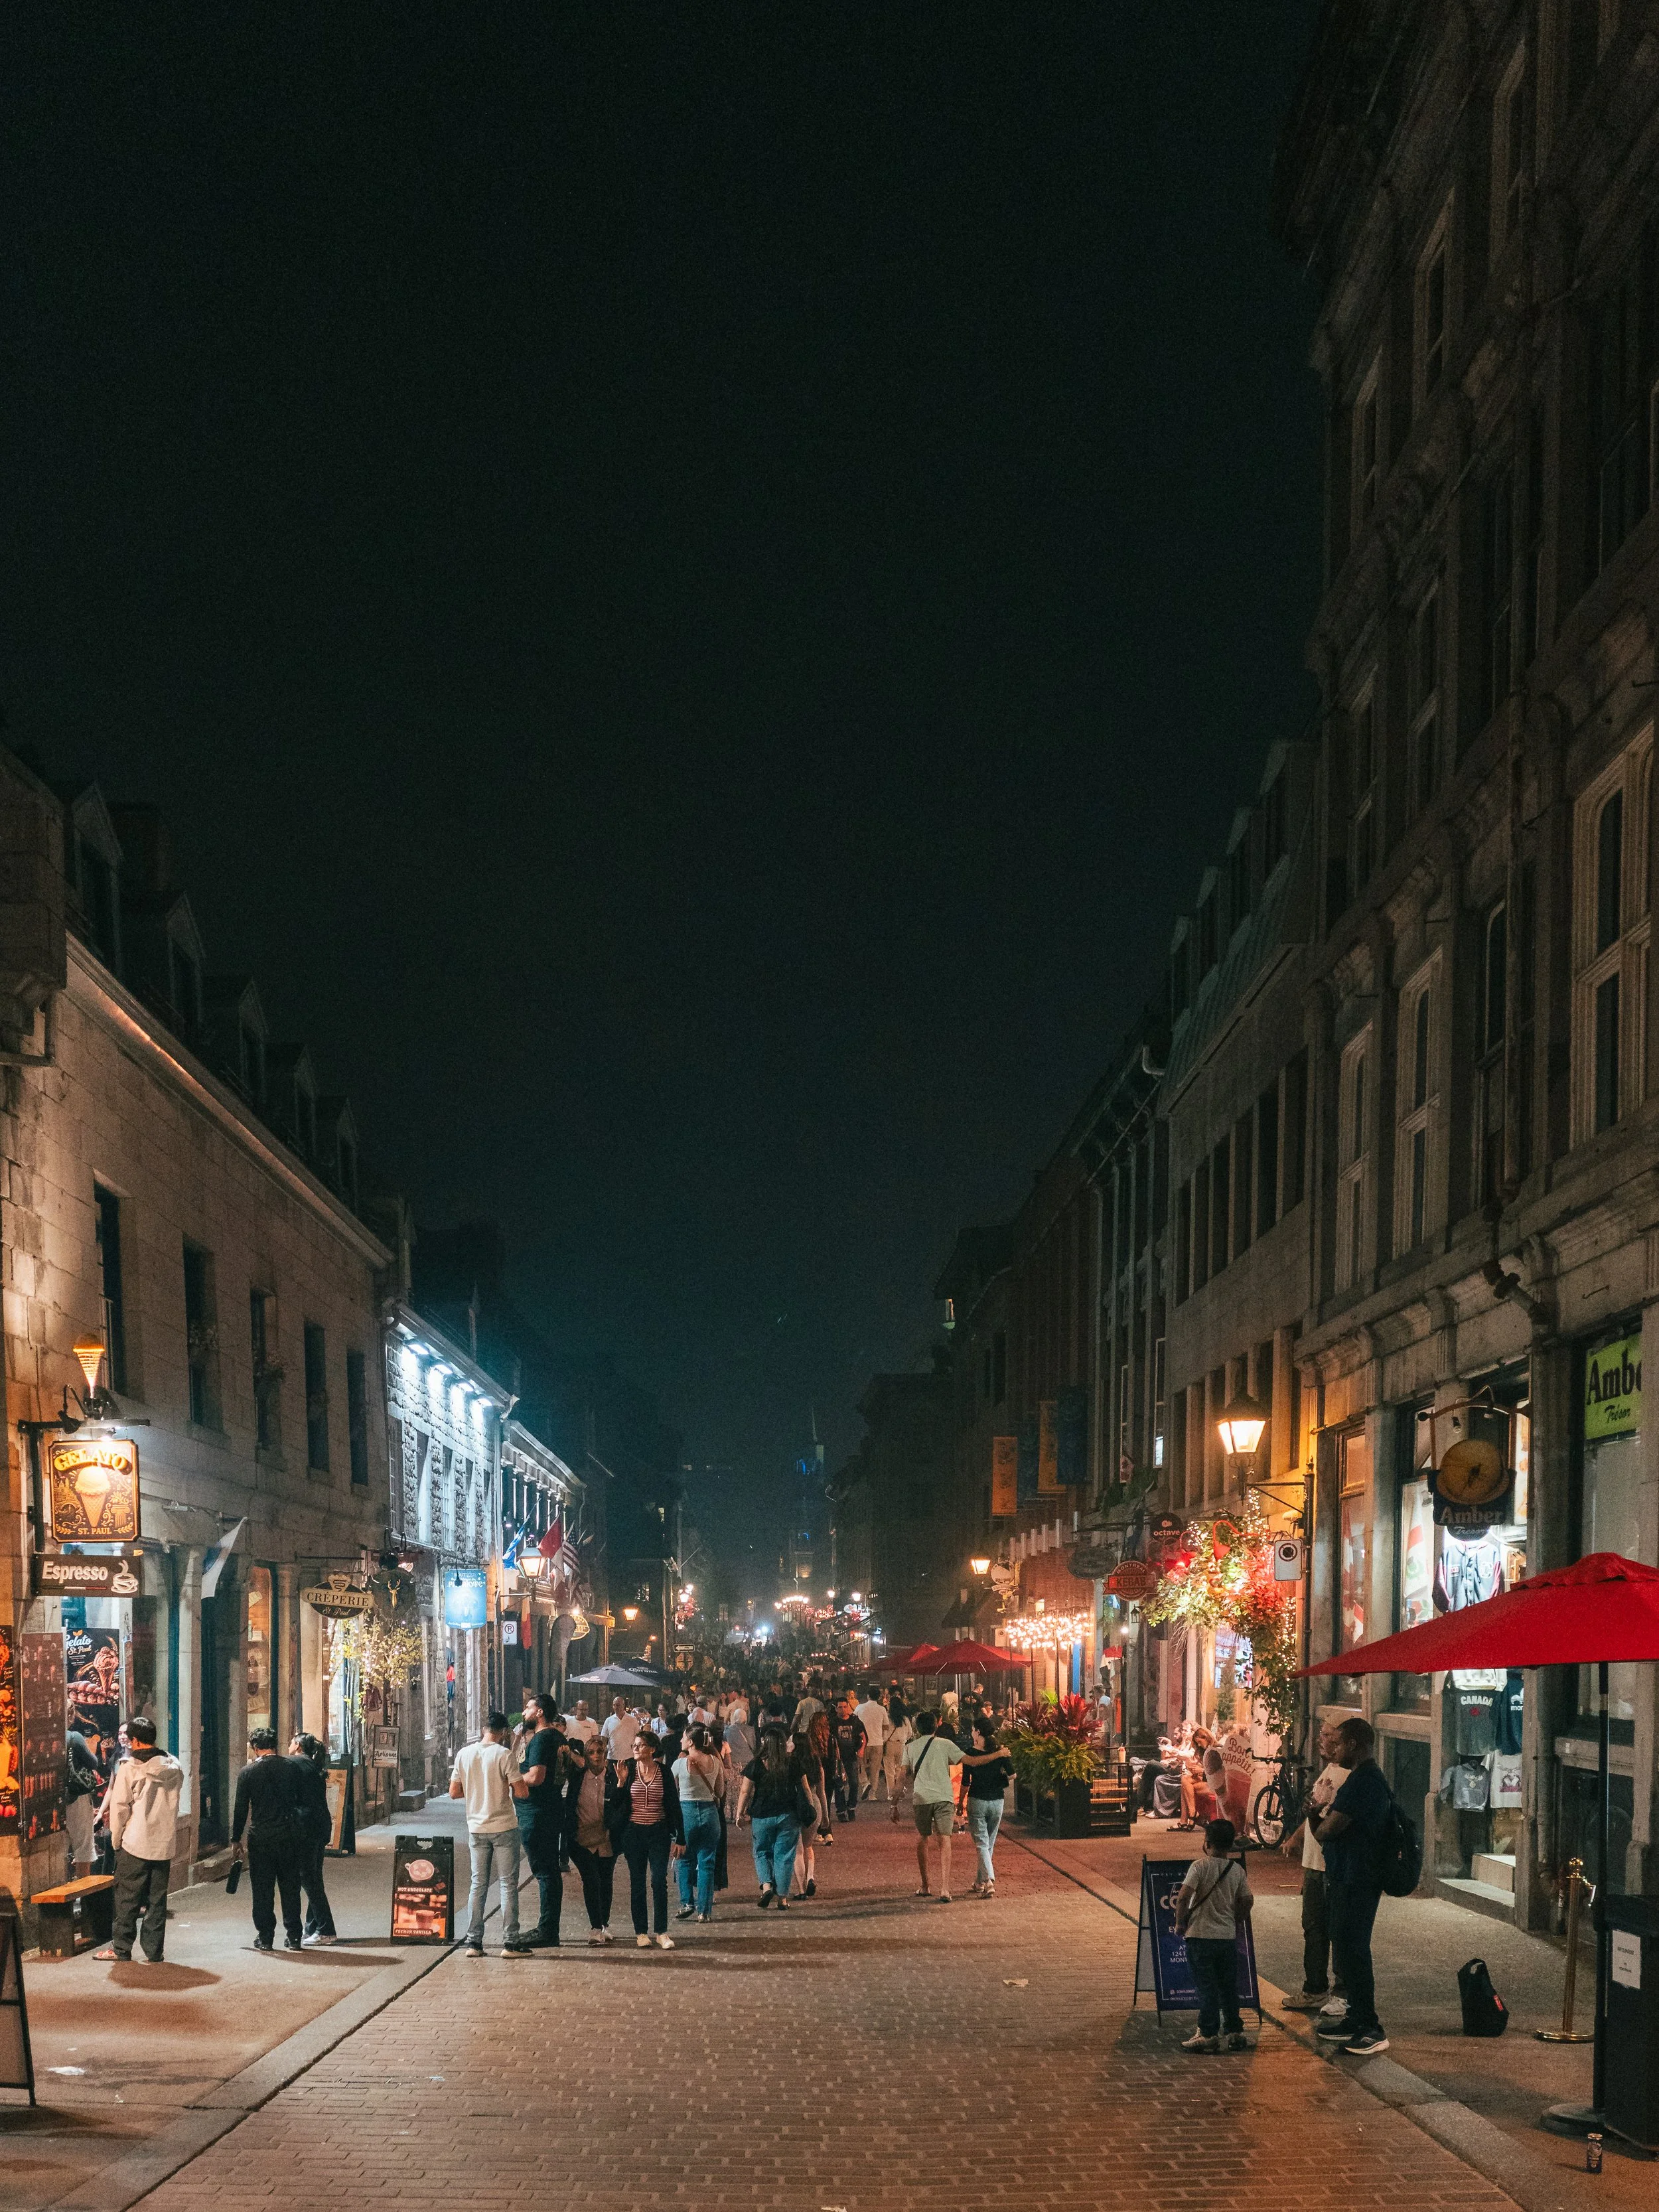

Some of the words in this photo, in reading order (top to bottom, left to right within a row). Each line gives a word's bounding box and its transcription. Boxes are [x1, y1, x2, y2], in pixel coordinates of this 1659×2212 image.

[54, 1448, 127, 1471] GELATO
[1439, 1505, 1504, 1524] Amber
[42, 1561, 109, 1584] Espresso
[1117, 1577, 1147, 1587] KEBAB
[307, 1591, 369, 1607] CRÊPERIE
[333, 1607, 351, 1616] Paul
[77, 1645, 92, 1655] Paul
[1460, 1695, 1493, 1707] CANADA
